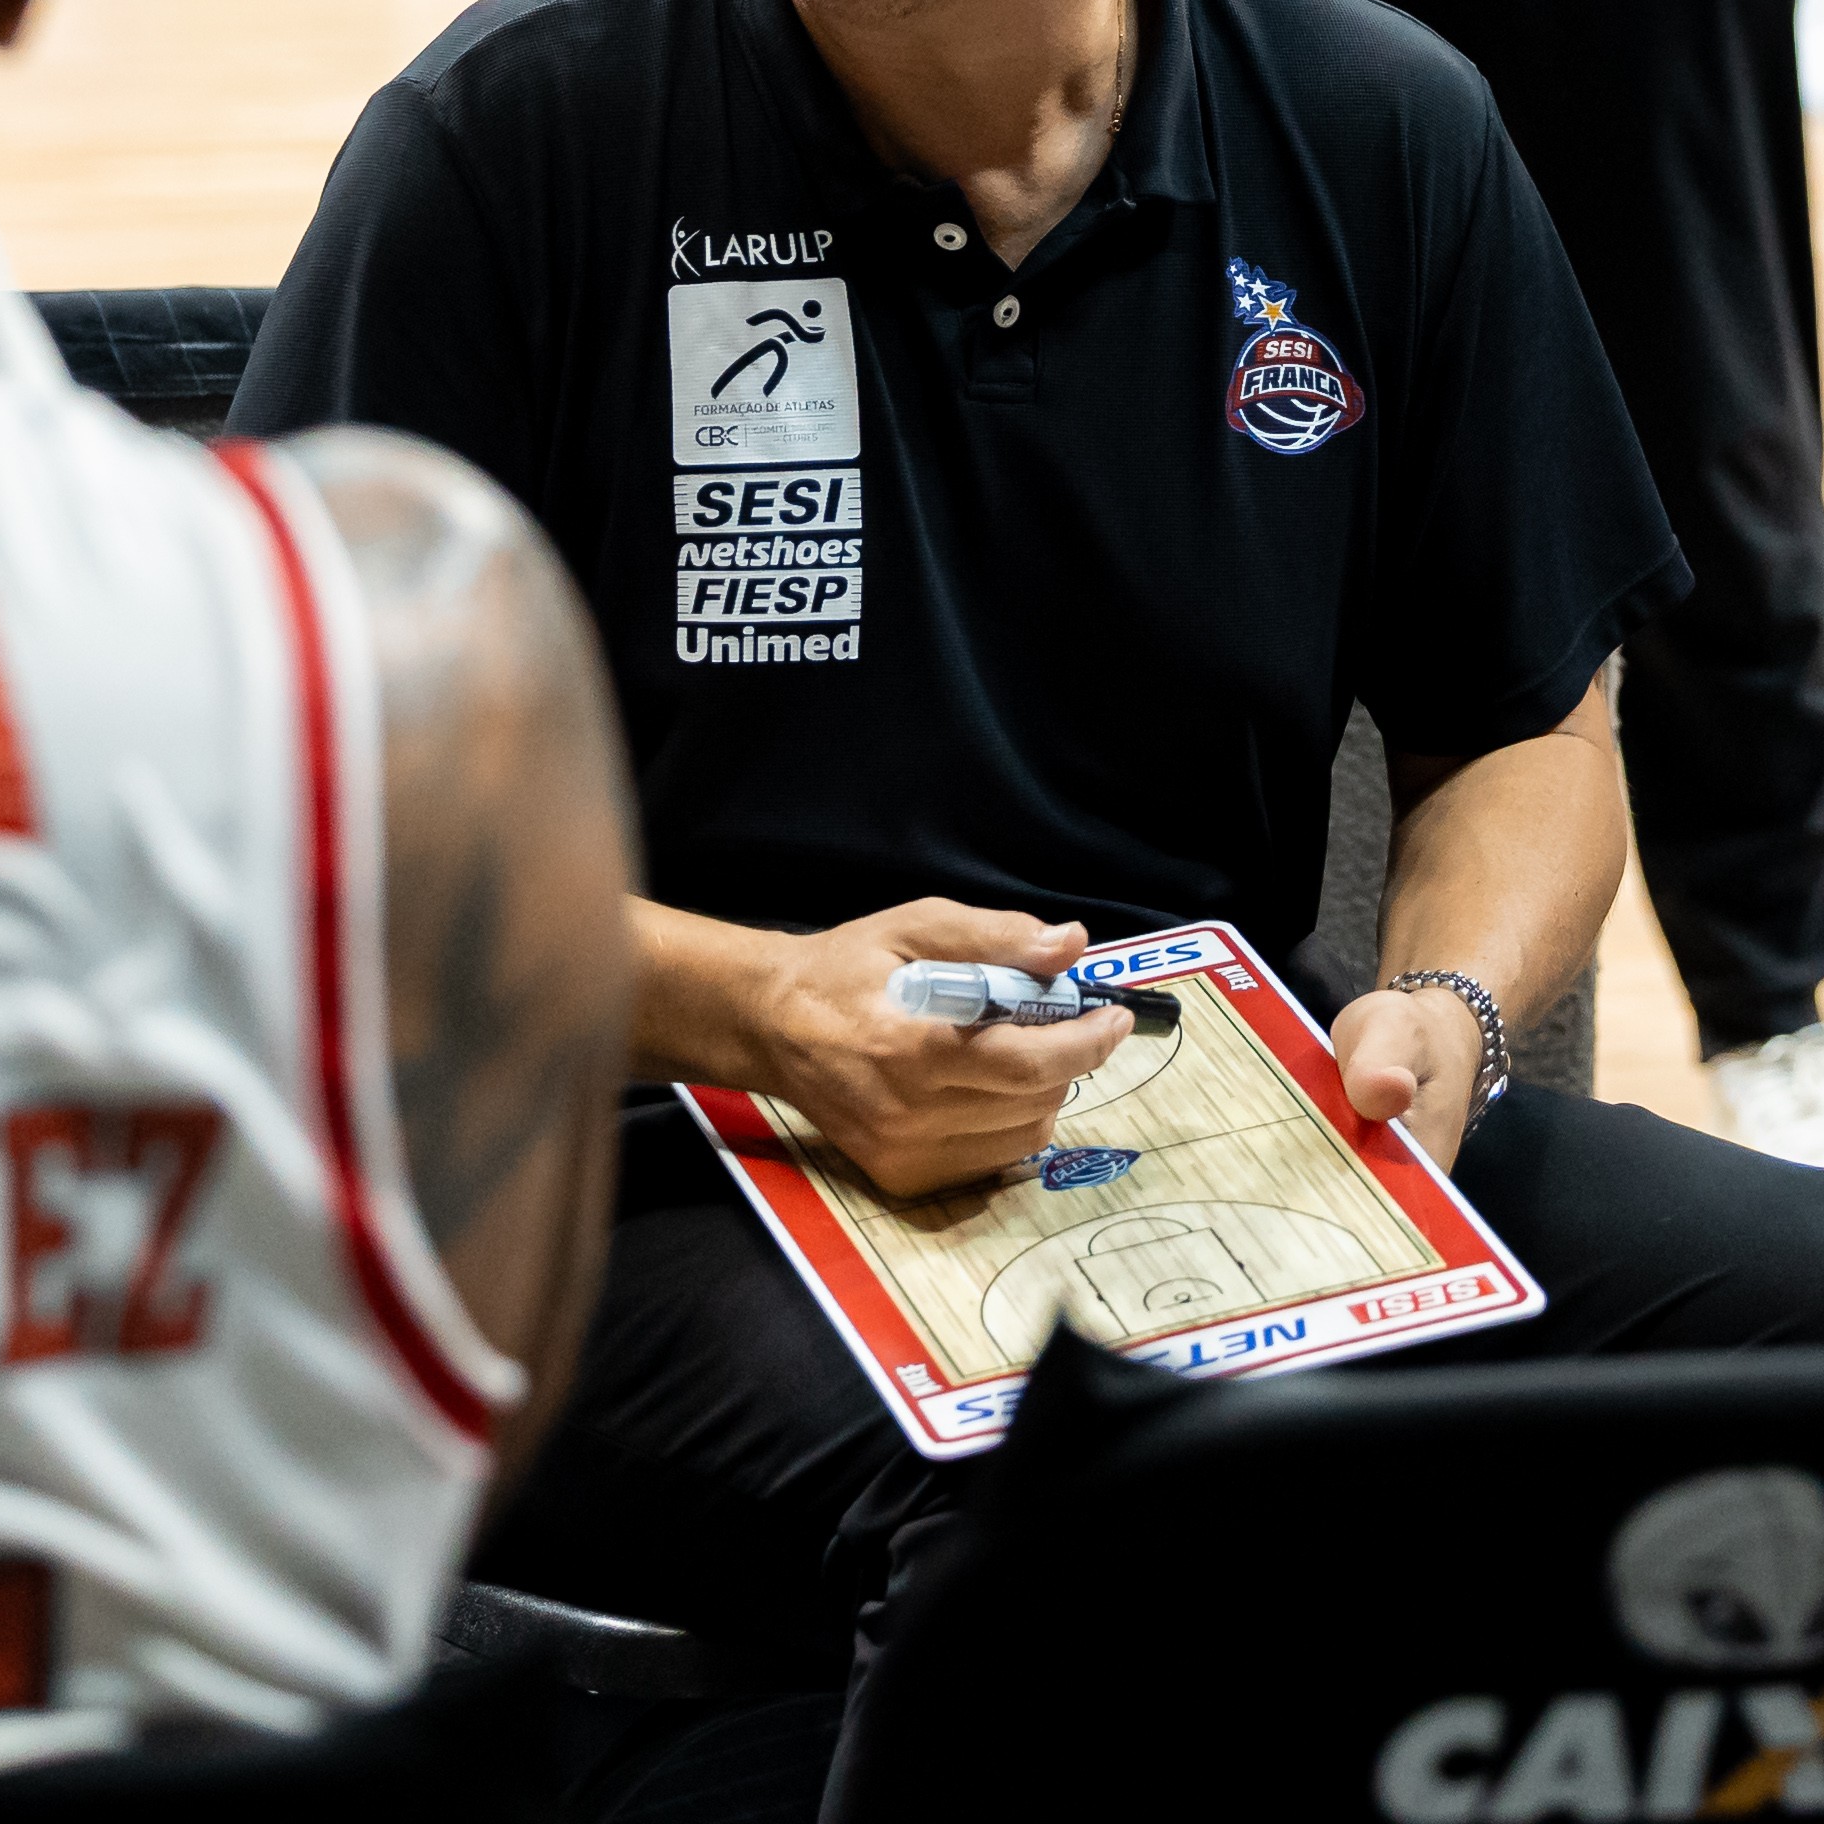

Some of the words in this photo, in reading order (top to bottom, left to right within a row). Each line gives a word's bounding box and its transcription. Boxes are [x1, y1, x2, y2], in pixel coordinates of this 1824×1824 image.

[1264, 340, 1313, 359] SESI
[1242, 365, 1343, 403] FRANCA
[693, 401, 763, 417] FORMAÇÃO
[766, 402, 780, 412] DE
[784, 399, 835, 412] ATLETAS
[695, 425, 739, 447] CBC
[692, 478, 844, 528] SESI
[690, 575, 849, 615] FIESP
[677, 625, 860, 663] Unimed
[1213, 963, 1261, 992] KIEF
[1367, 1275, 1483, 1323] SESI
